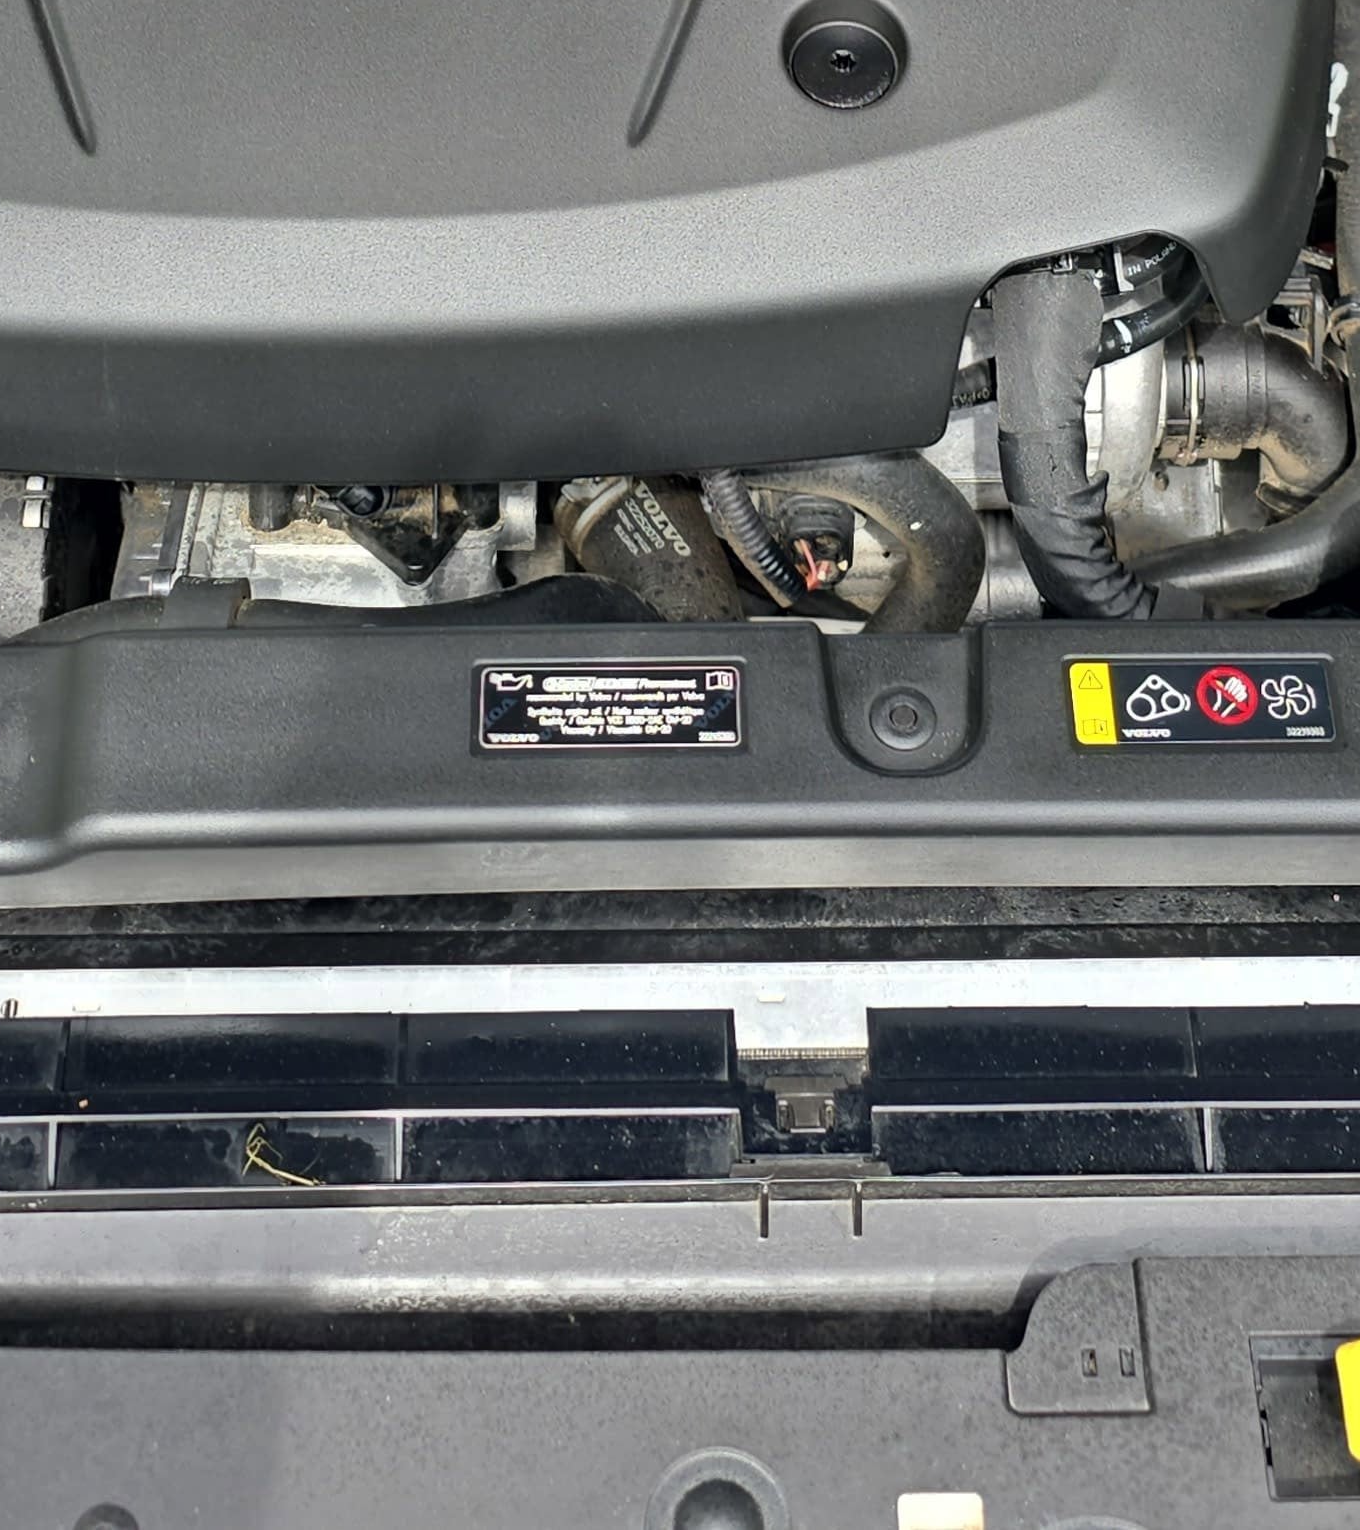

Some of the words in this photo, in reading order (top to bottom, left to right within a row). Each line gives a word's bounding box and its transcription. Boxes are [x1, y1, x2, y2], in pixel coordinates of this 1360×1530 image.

[1127, 264, 1142, 277] IN
[634, 480, 692, 560] VOLVO
[487, 733, 540, 743] VOLVO
[1123, 728, 1171, 738] VOLVO
